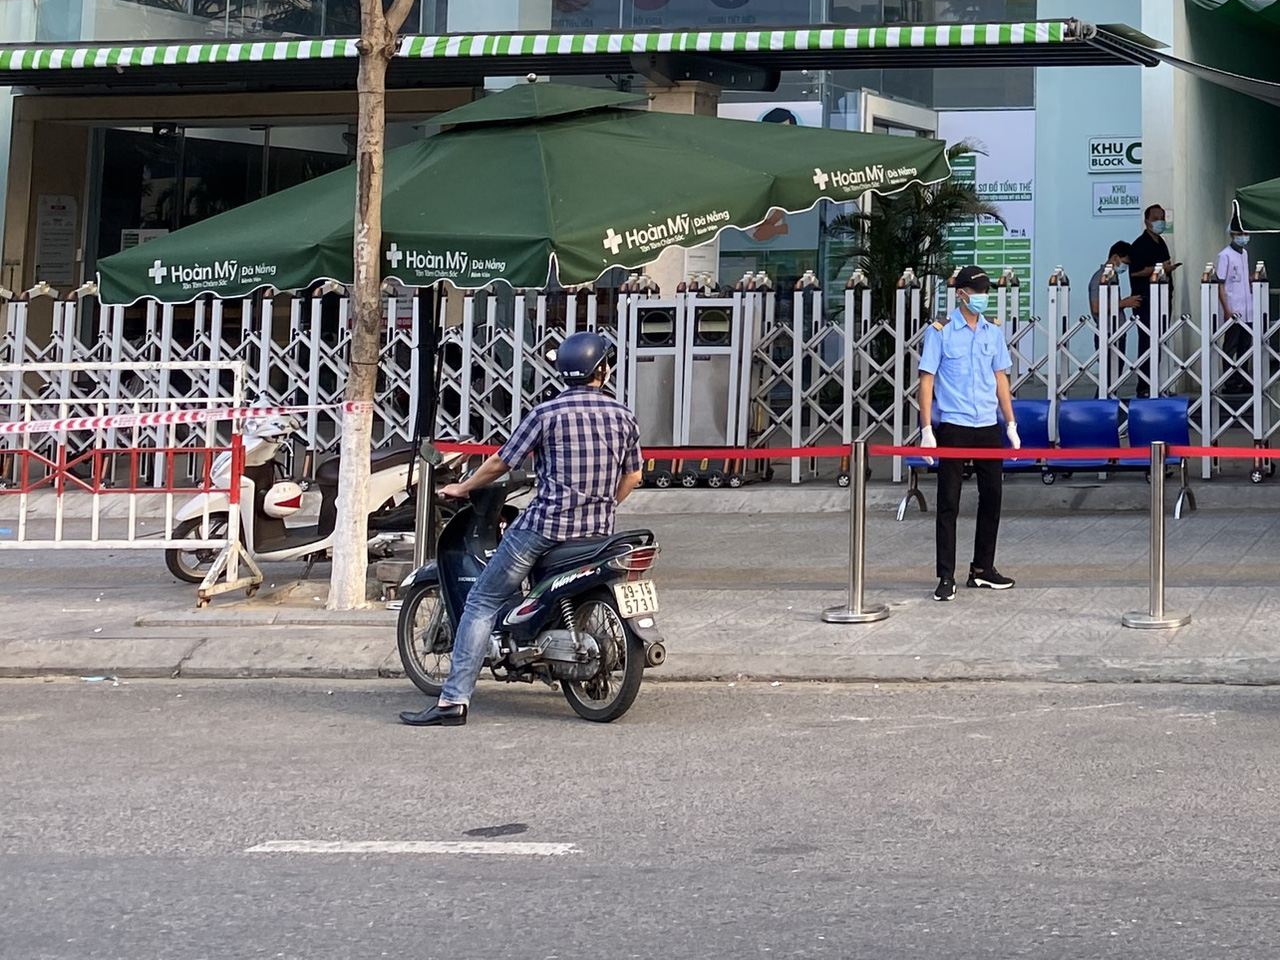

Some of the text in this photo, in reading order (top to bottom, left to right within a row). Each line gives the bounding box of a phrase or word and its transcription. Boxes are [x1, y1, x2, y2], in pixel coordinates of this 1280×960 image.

[1091, 143, 1123, 154] KHU
[1126, 142, 1142, 164] C
[1091, 158, 1124, 166] BLOCK
[830, 165, 885, 187] Hoàn Mỹ
[887, 169, 898, 178] Đà
[1112, 185, 1126, 194] KHU
[1121, 195, 1139, 206] BỆNH
[694, 217, 706, 227] Đà
[625, 213, 690, 249] Hoàn Mỹ
[406, 250, 468, 273] Hoàn Mỹ
[472, 259, 483, 270] Đà
[171, 260, 238, 282] Hoàn Mỹ
[242, 265, 253, 276] Đà
[621, 582, 652, 599] 29-T5
[625, 596, 655, 614] 5731
